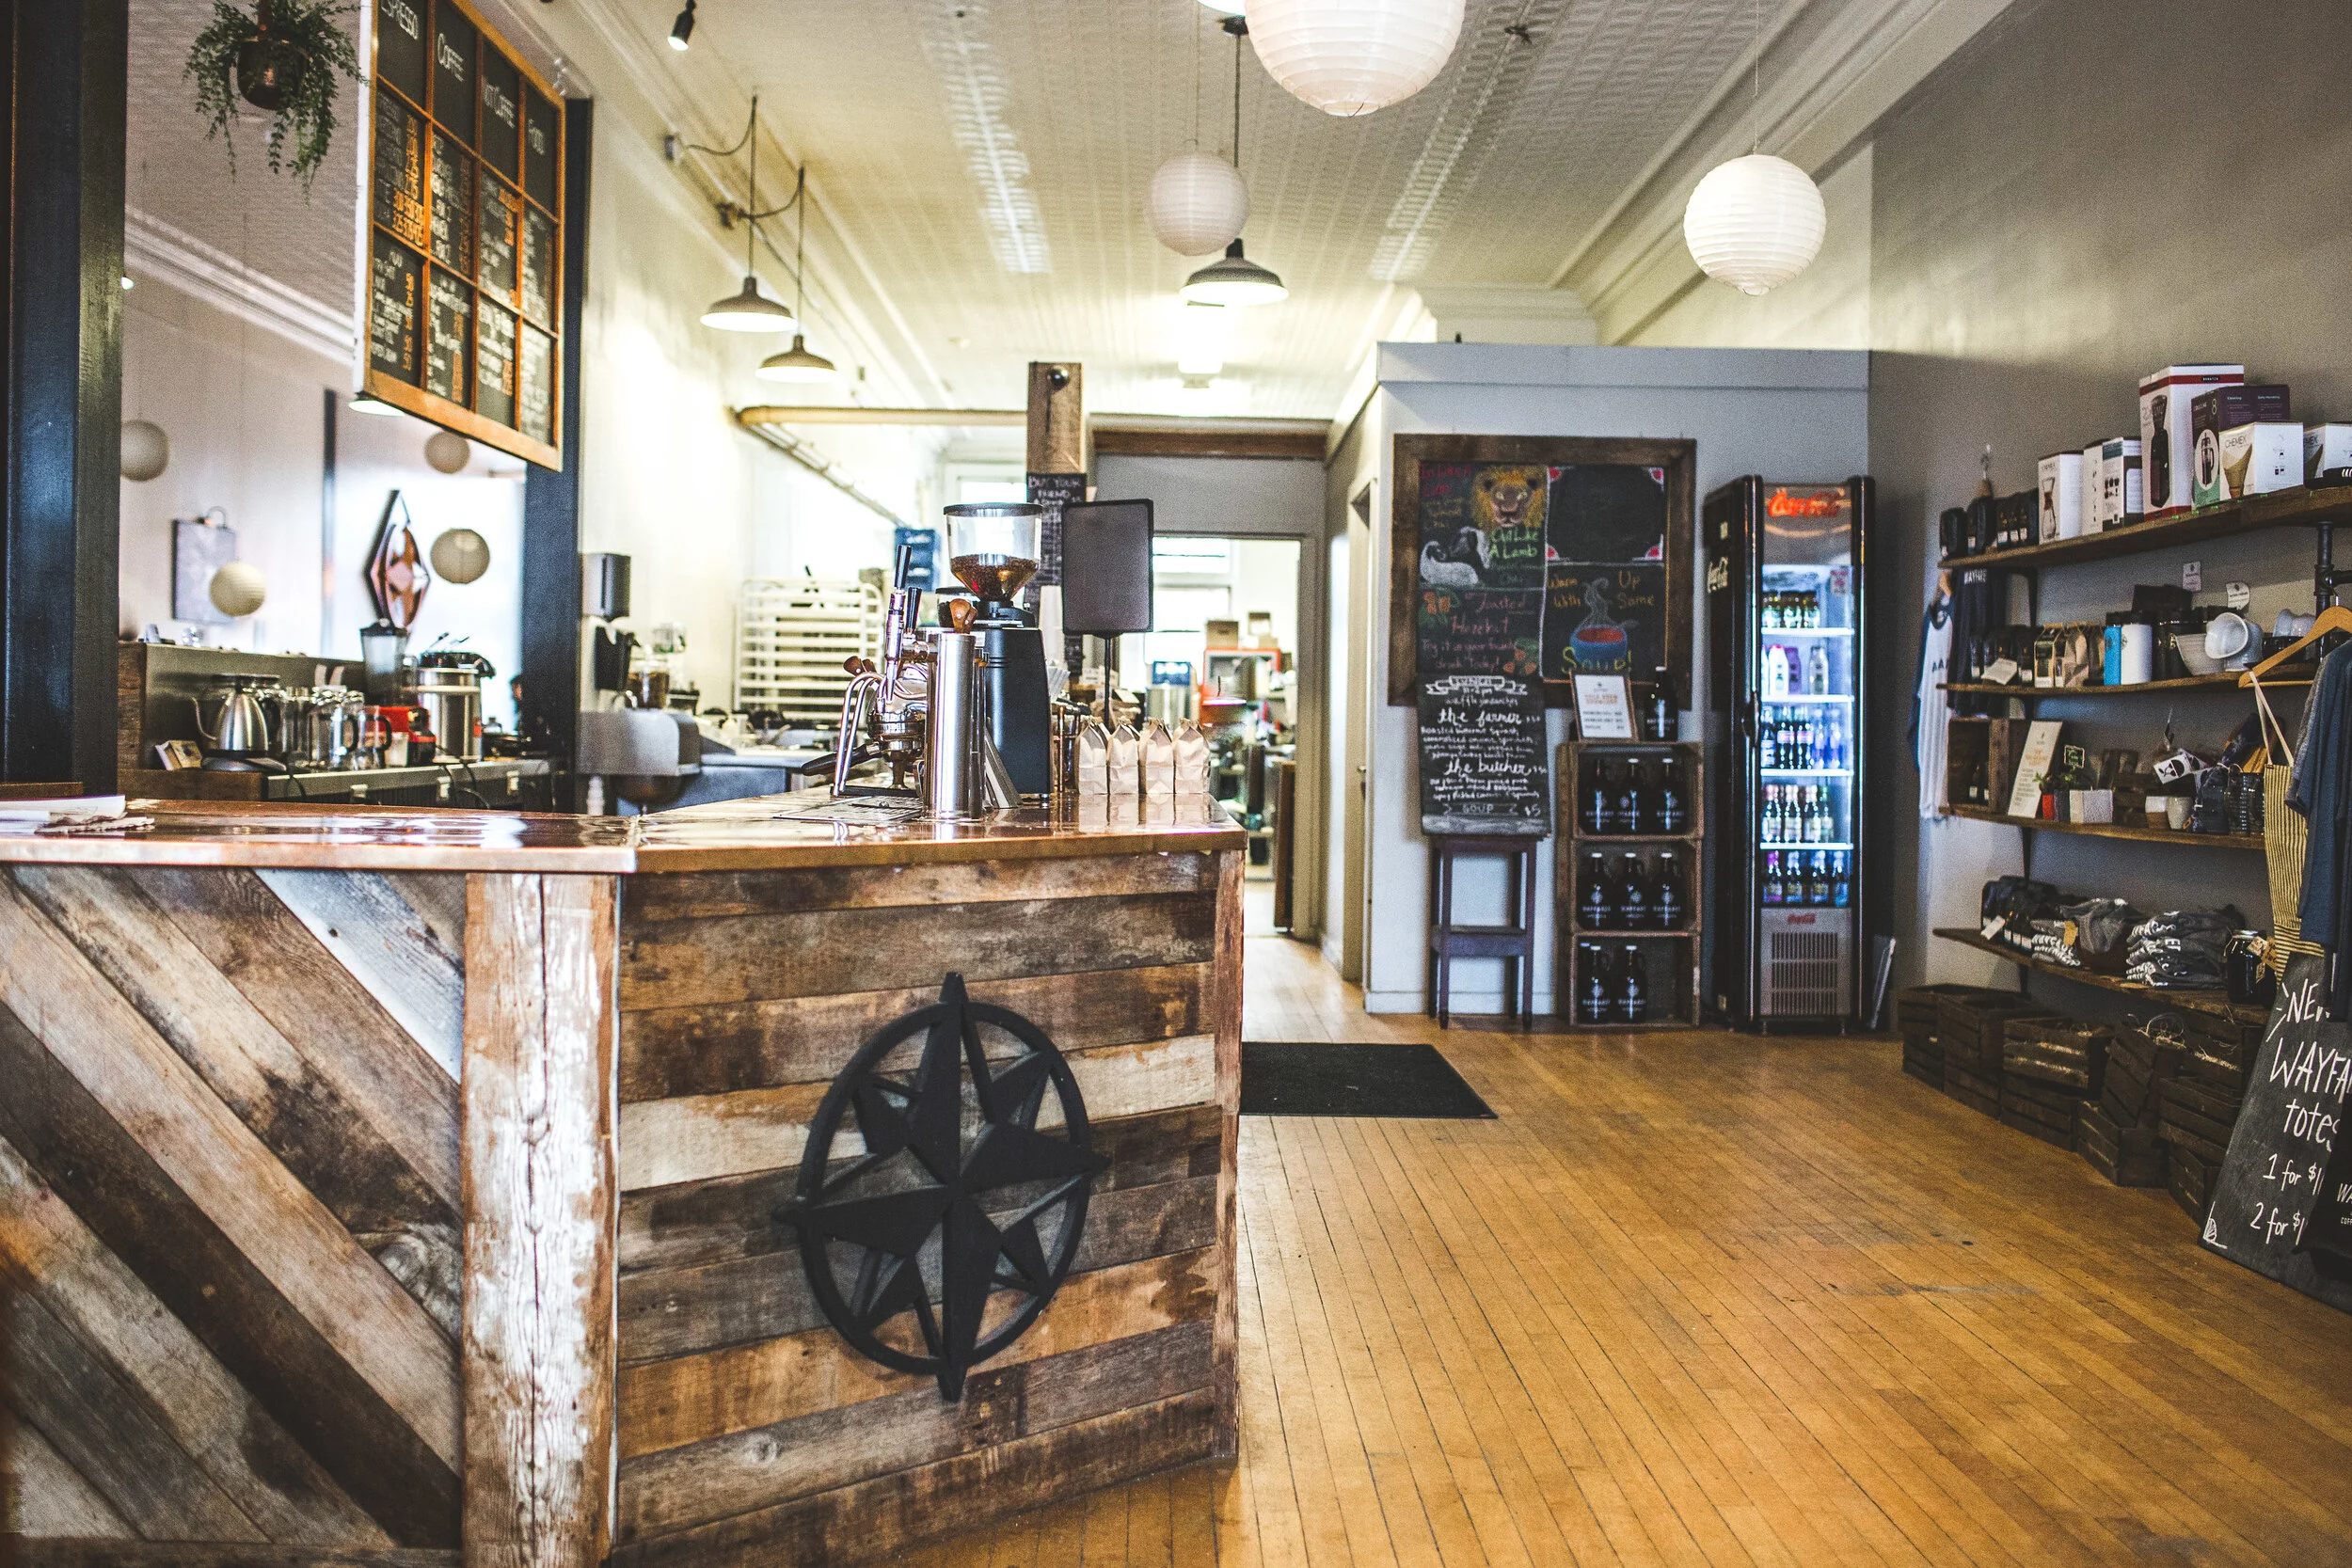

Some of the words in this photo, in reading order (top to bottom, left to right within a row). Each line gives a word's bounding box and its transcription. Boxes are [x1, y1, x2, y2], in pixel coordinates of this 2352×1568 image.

[1438, 706, 1468, 728] the
[1475, 710, 1522, 727] farmer
[1443, 757, 1472, 779] the
[1478, 754, 1532, 776] butcher
[2286, 977, 2331, 1023] NE
[2269, 1037, 2352, 1104] WAYFA
[2262, 1152, 2278, 1180] 1
[2280, 1159, 2302, 1192] for
[2249, 1201, 2265, 1230] 2
[2265, 1207, 2290, 1244] for
